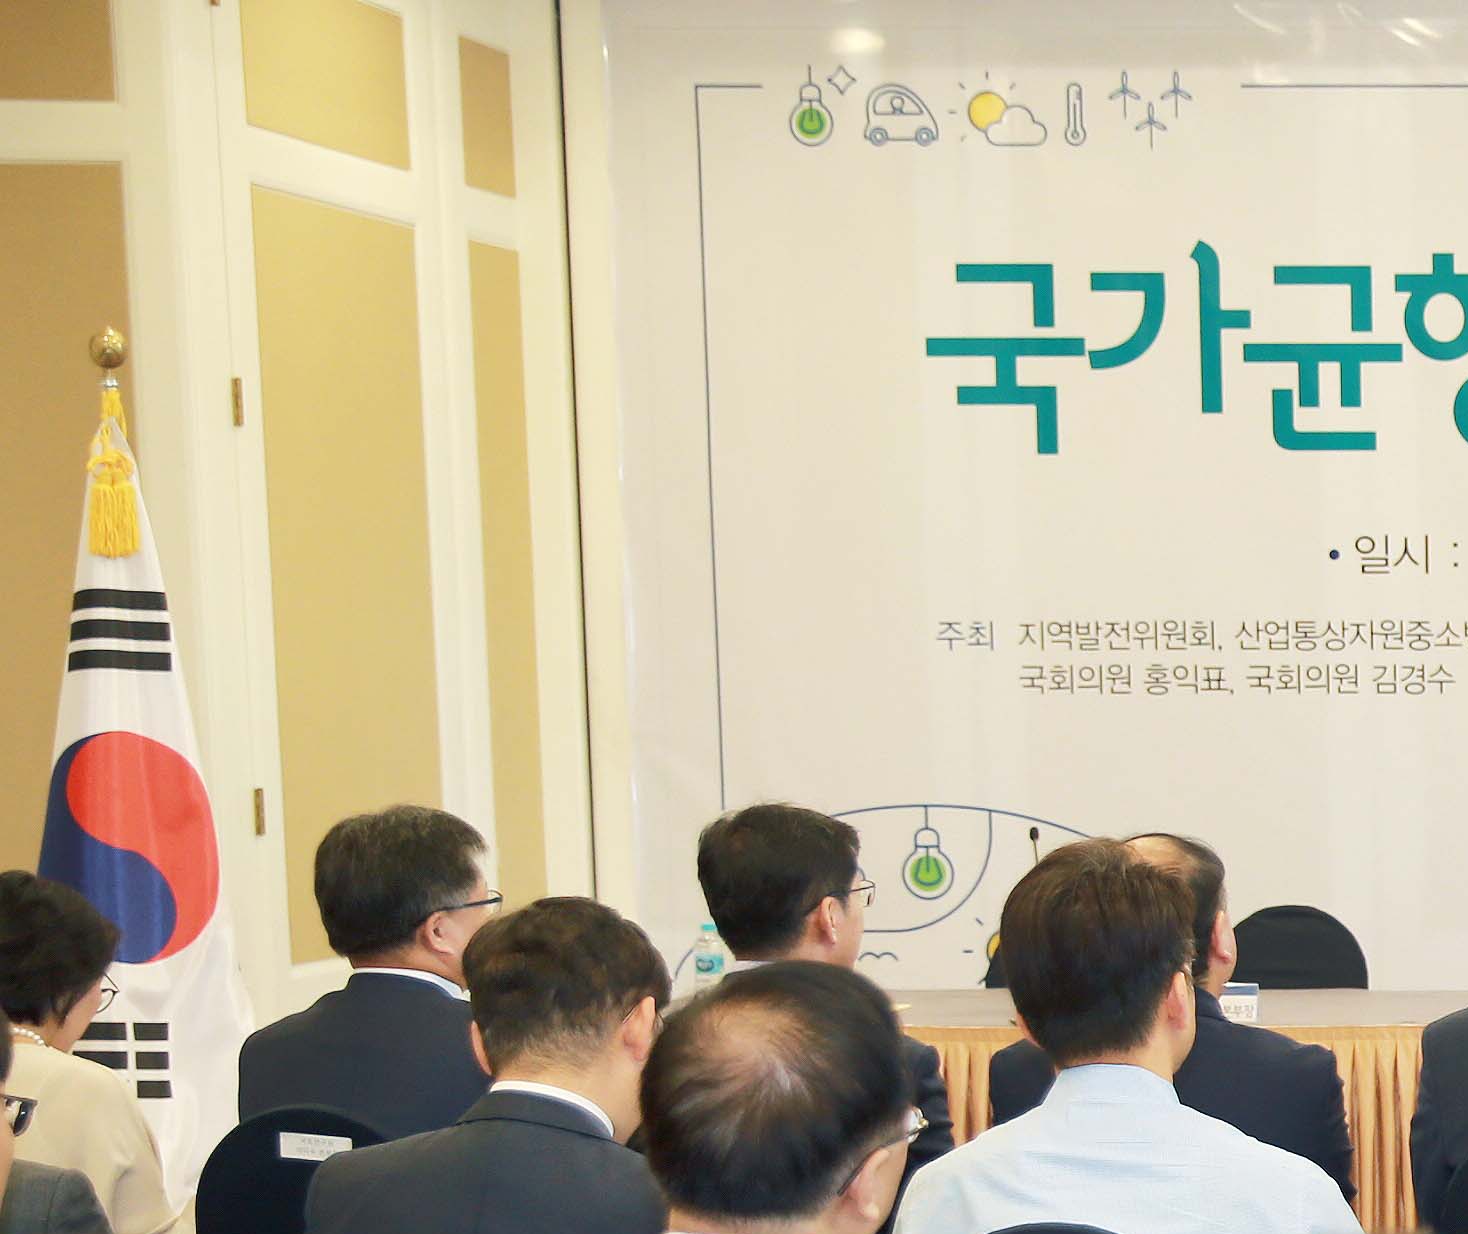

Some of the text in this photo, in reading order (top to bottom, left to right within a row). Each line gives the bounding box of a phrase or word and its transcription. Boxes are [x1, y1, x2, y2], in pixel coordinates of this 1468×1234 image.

[1354, 534, 1432, 575] 일시
[936, 620, 995, 651] 주최
[1017, 620, 1223, 651] 지역발전위원회,
[1019, 663, 1456, 695] 국회의원 홍익표, 국회의원 김경수
